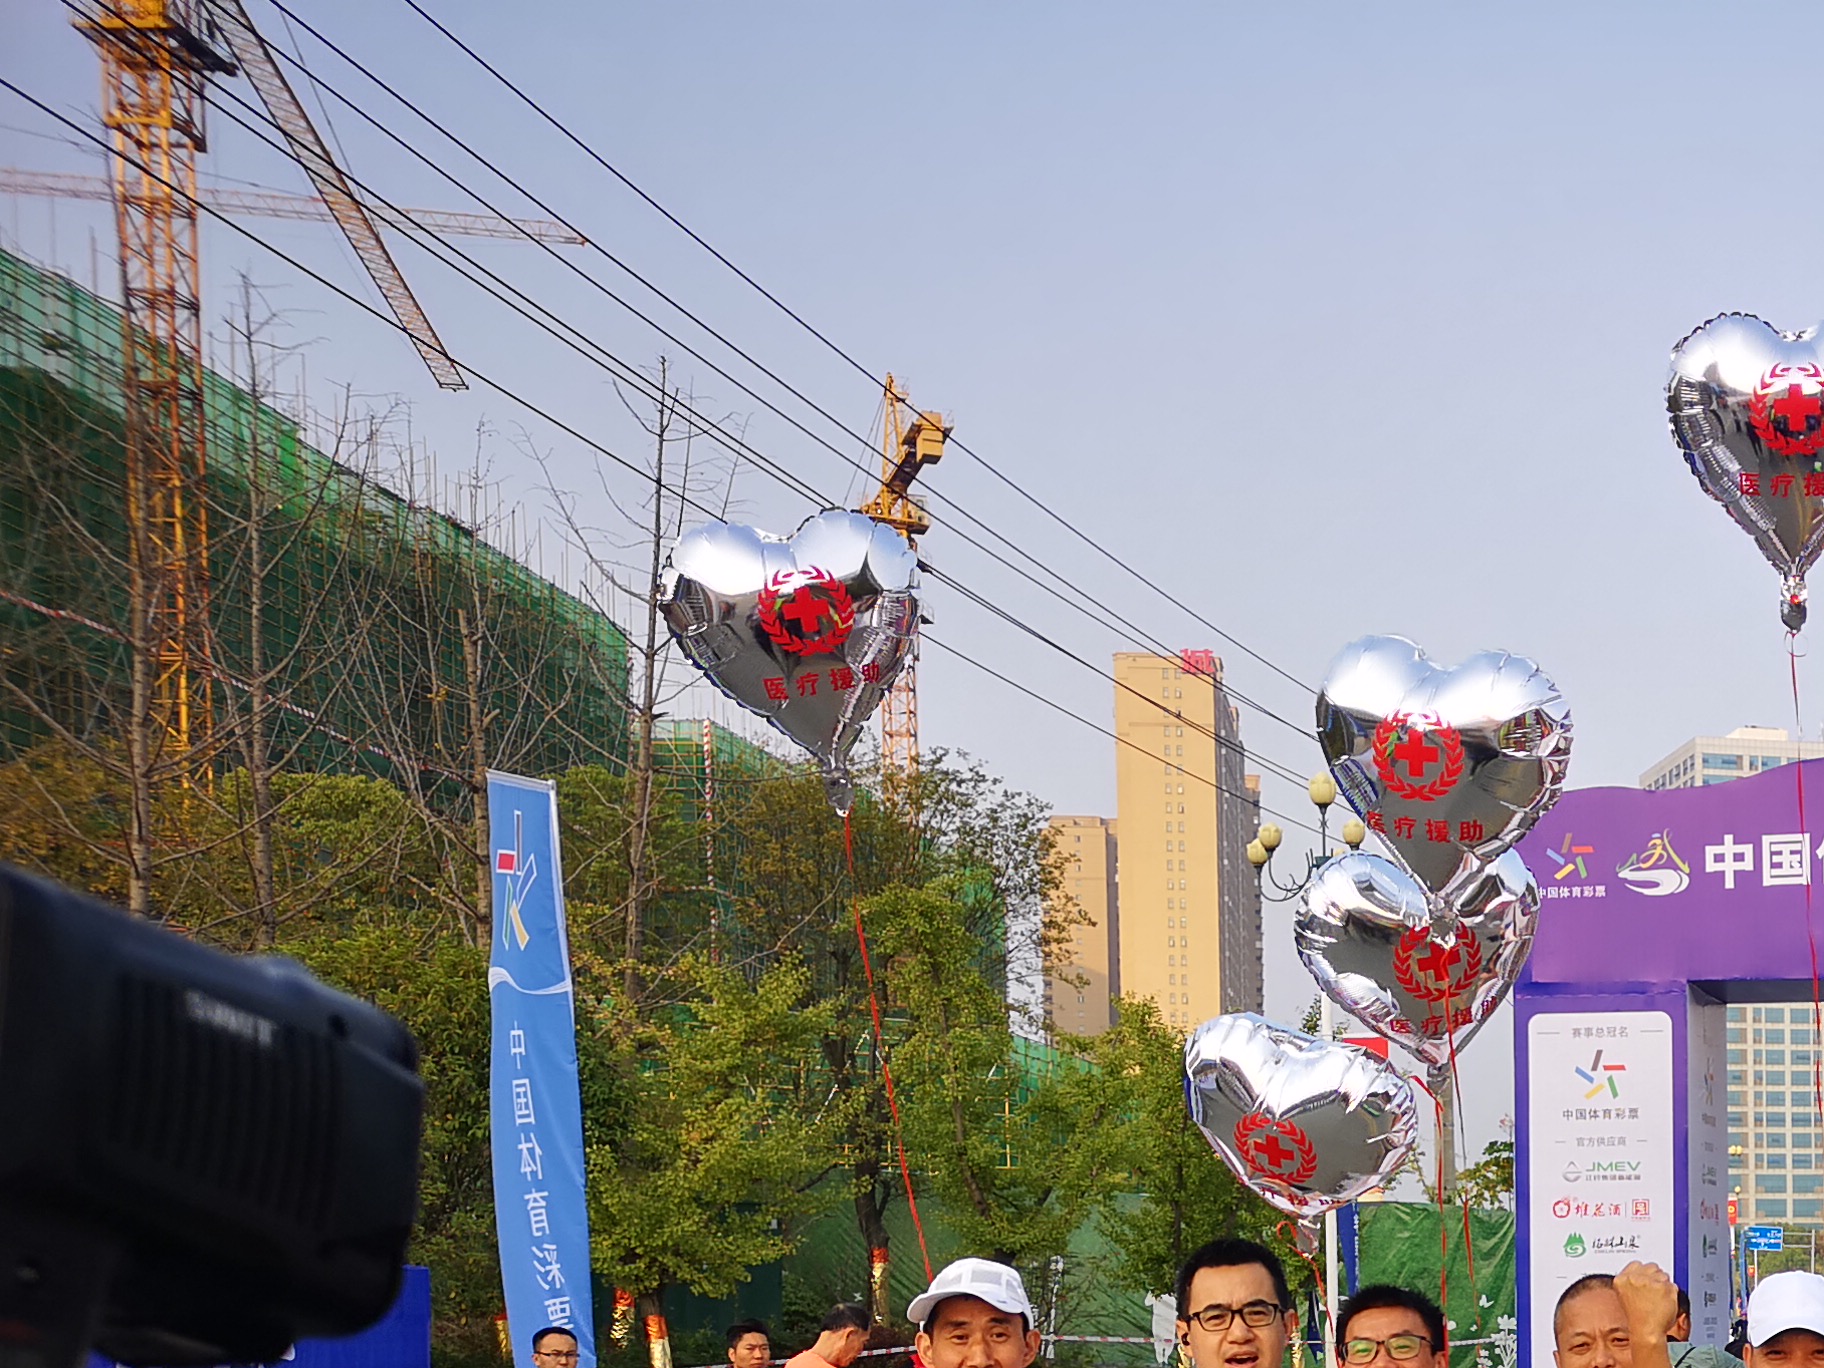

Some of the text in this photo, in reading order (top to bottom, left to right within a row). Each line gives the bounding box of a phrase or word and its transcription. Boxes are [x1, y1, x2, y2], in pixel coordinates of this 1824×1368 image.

[762, 664, 880, 701] 医疗援助
[1367, 810, 1484, 843] 医疗援助
[1571, 1026, 1630, 1040] 赛事总冠名
[1562, 1107, 1640, 1121] 中国体育彩票
[1585, 1161, 1642, 1172] JMEV
